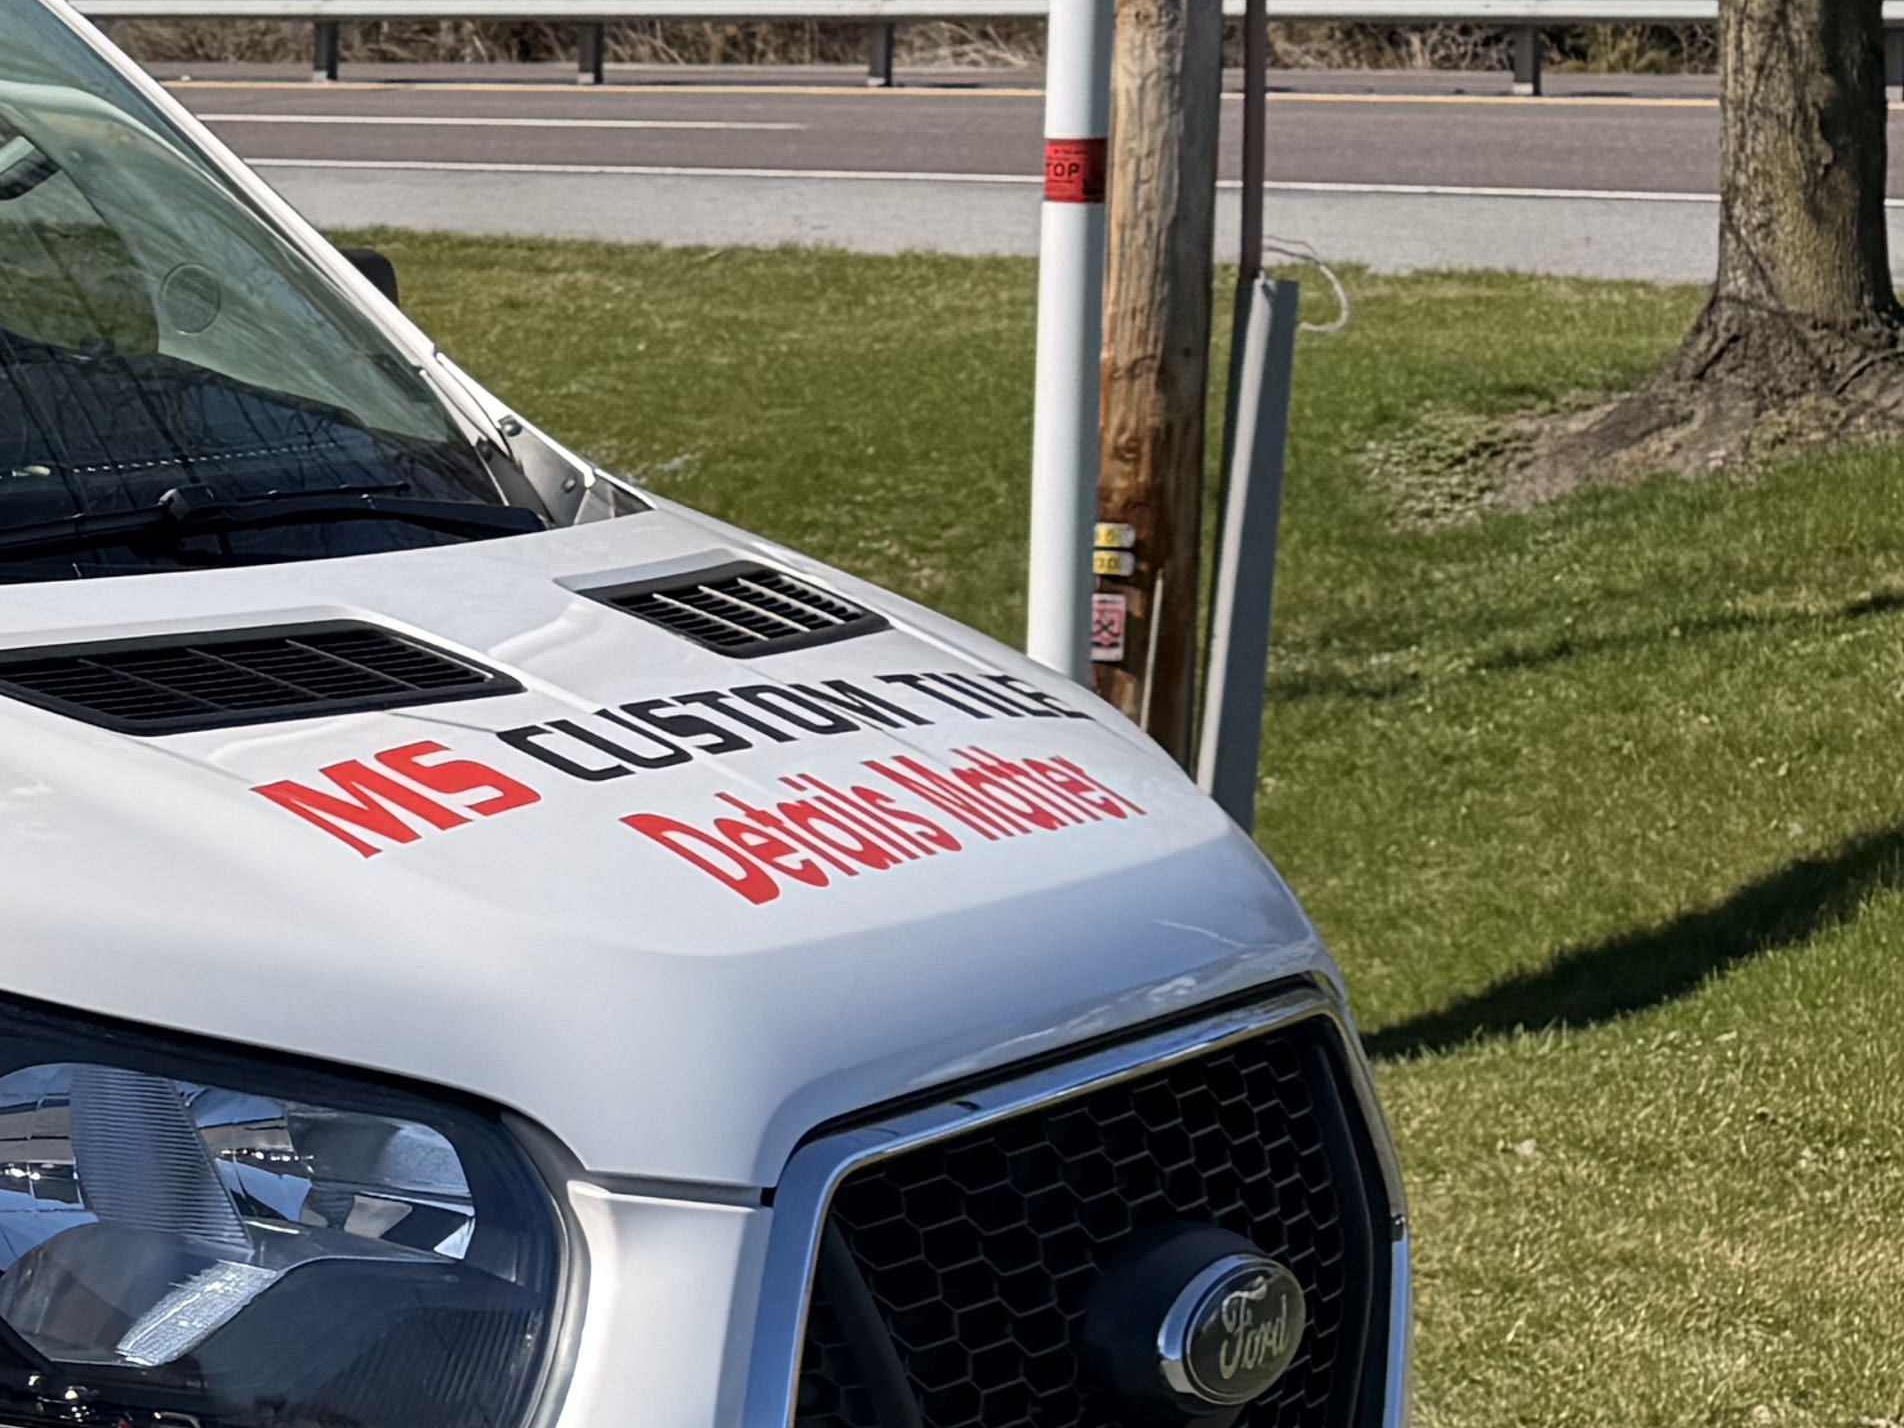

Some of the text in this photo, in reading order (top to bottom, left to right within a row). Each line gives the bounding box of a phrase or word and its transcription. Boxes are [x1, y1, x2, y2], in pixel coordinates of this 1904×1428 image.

[252, 671, 1090, 859] MS CUSTOM TILE
[619, 745, 1147, 907] Details Matter
[1219, 1275, 1288, 1380] Ford
